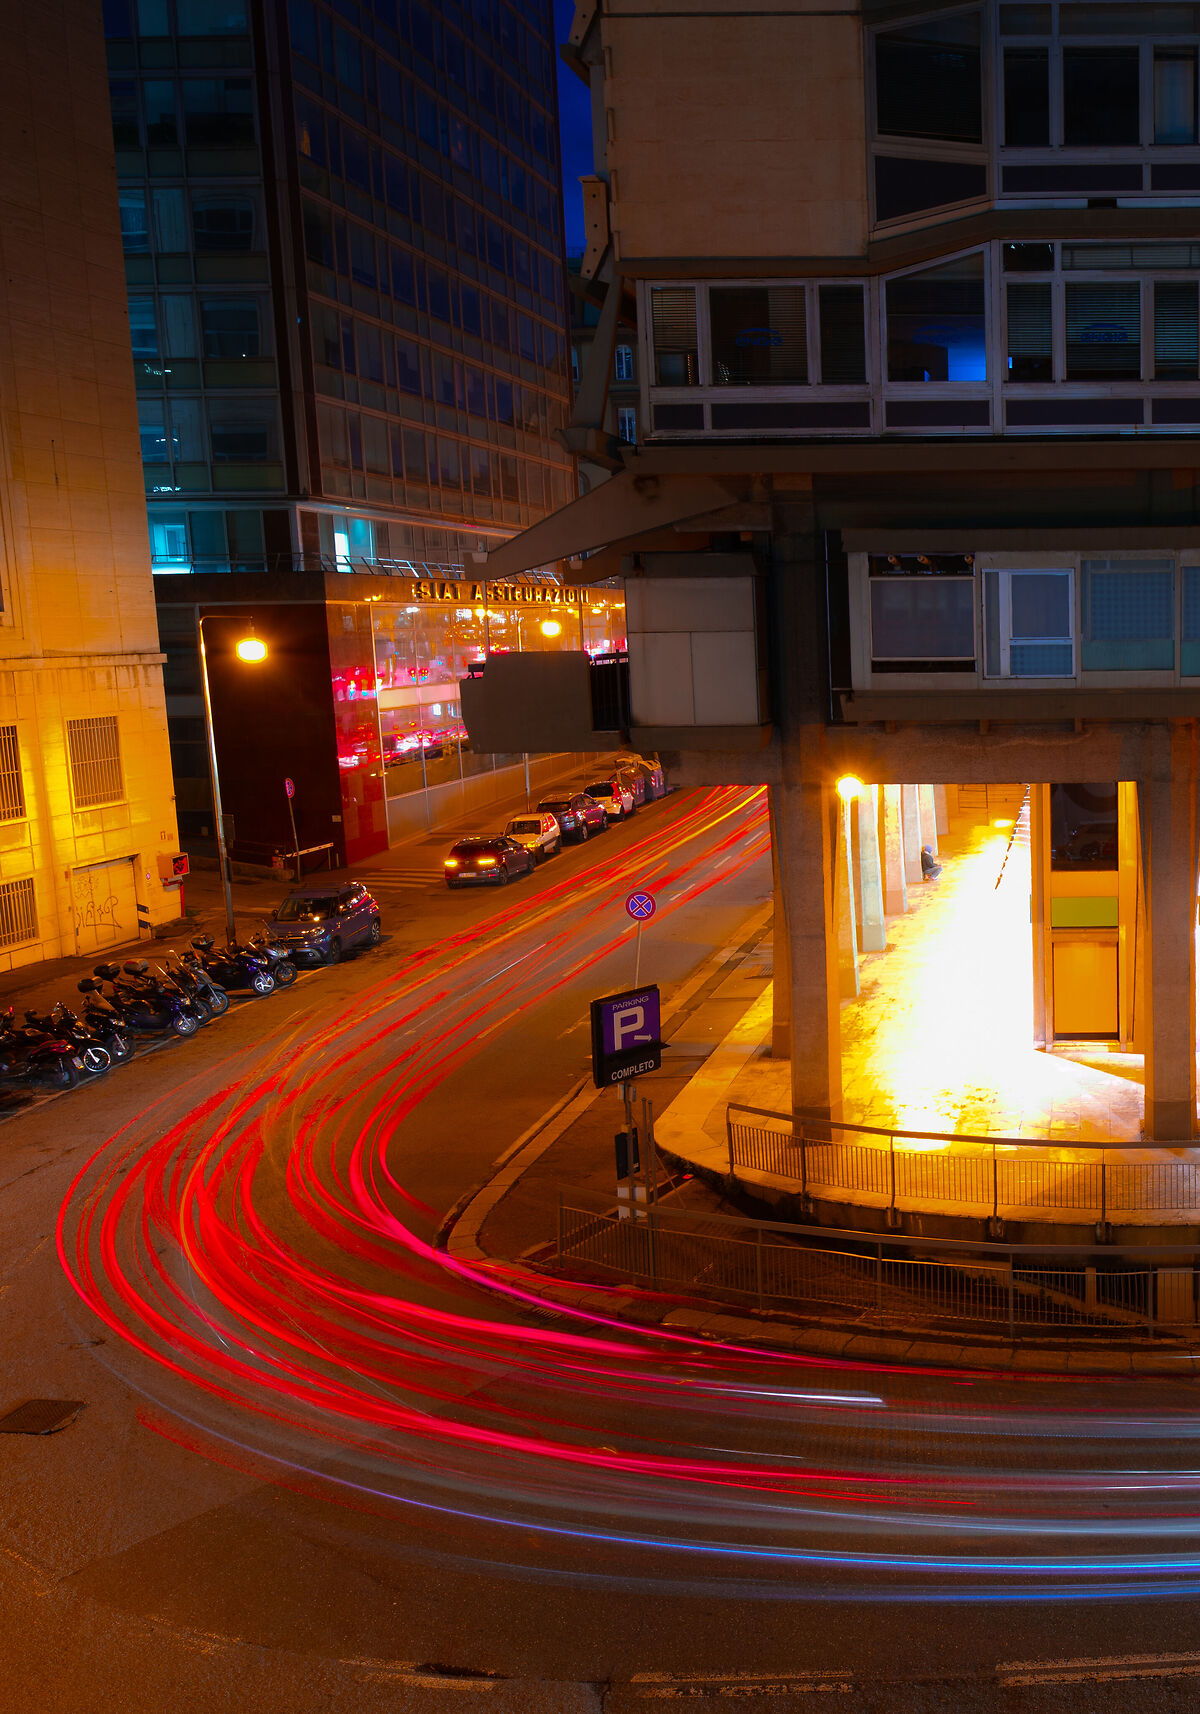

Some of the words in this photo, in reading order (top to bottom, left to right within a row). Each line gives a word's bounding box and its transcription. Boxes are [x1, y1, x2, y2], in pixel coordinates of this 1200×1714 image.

[612, 996, 649, 1011] PARKING
[613, 1005, 645, 1051] P
[611, 1059, 655, 1080] COMPLETO
